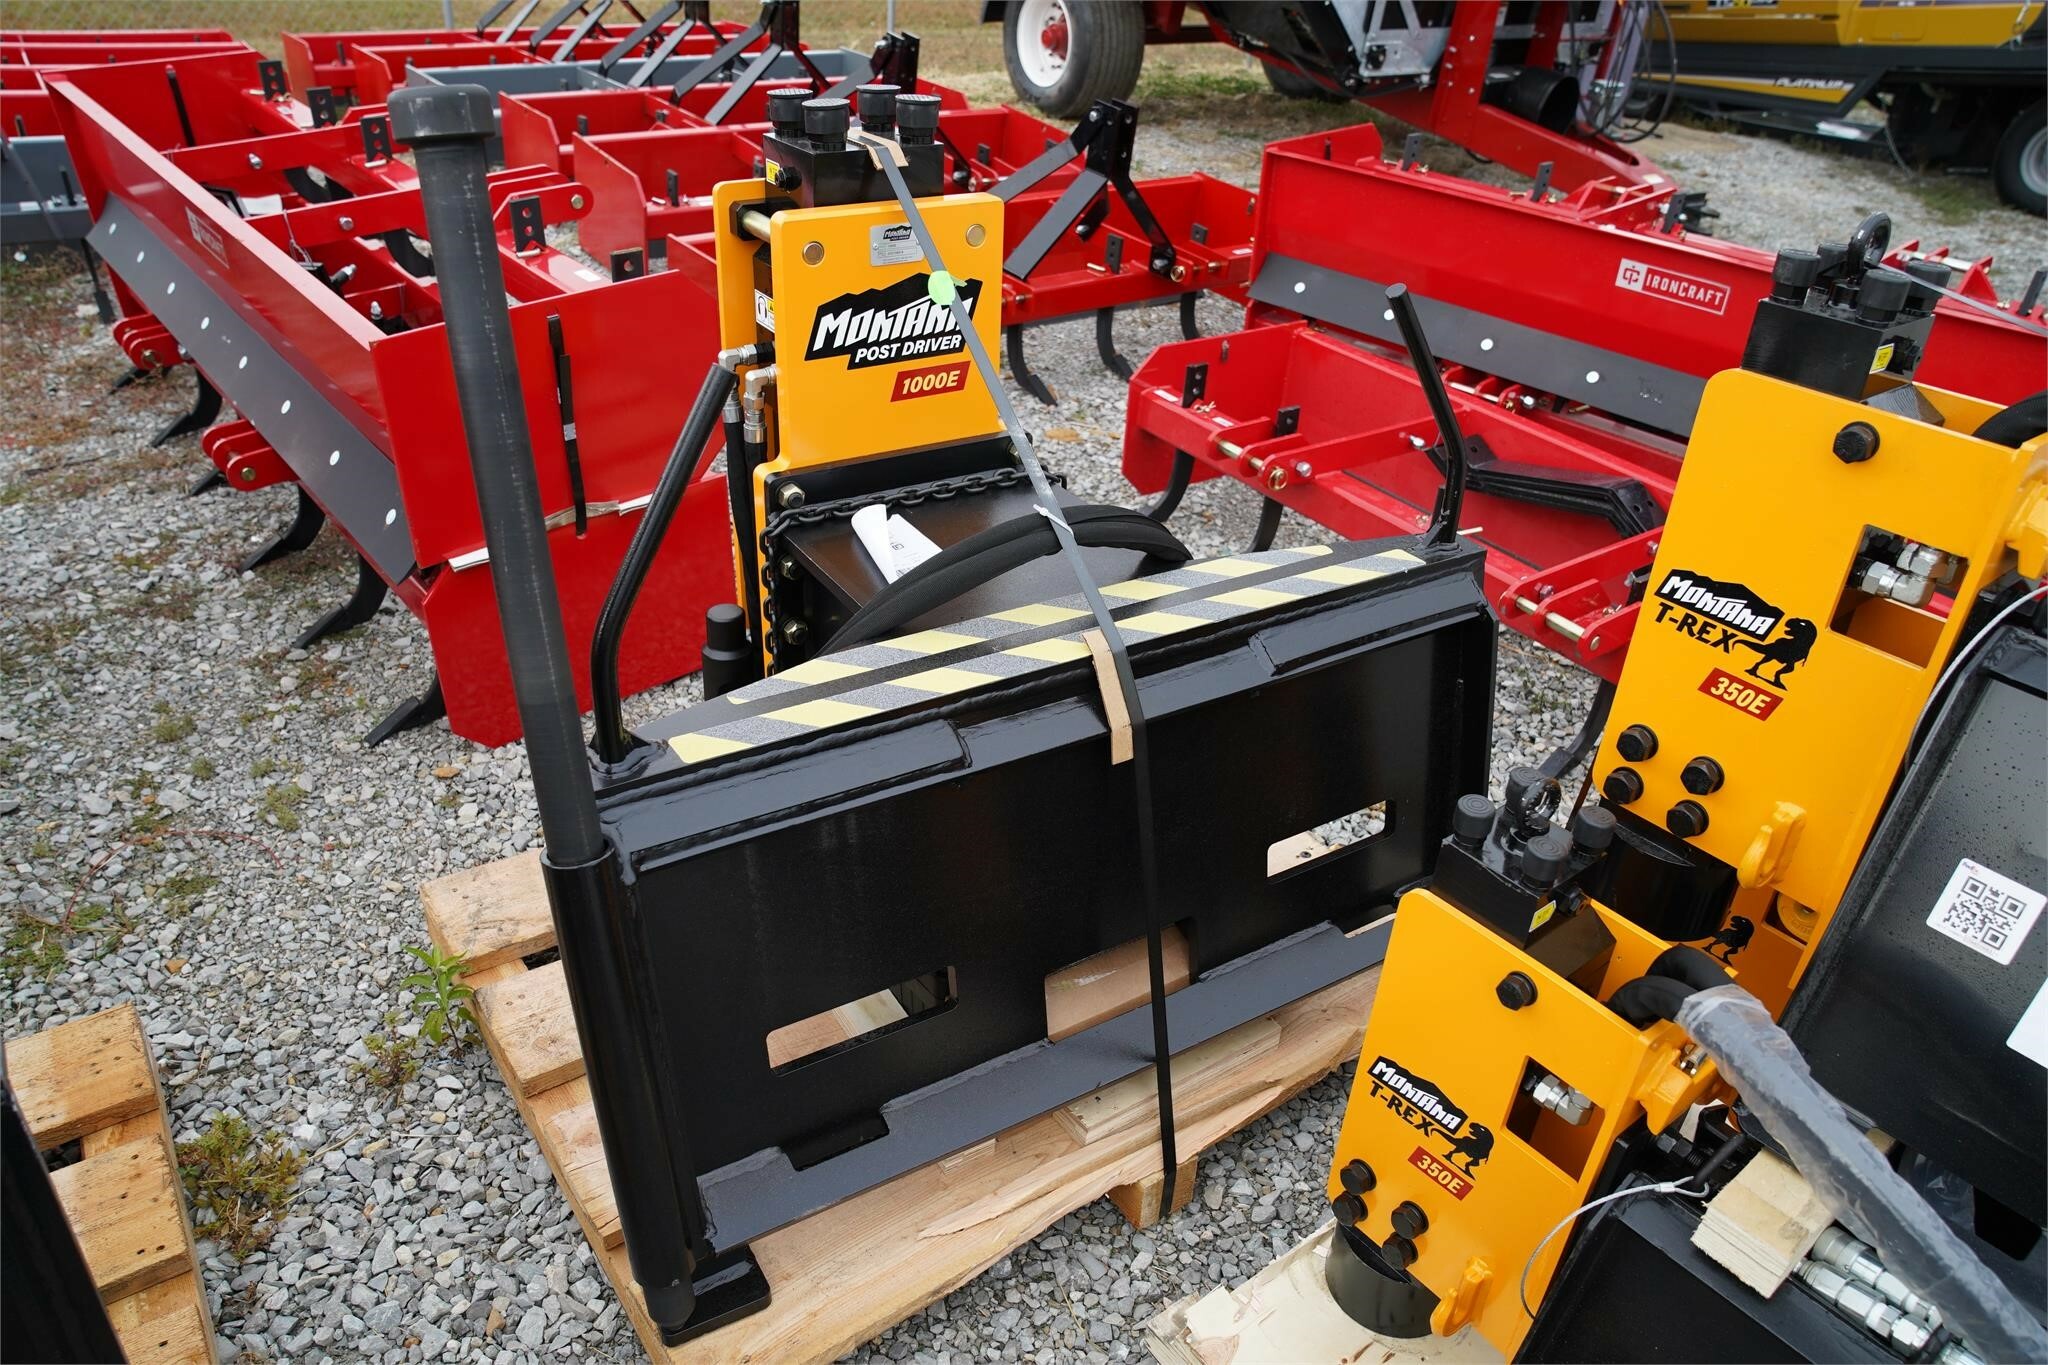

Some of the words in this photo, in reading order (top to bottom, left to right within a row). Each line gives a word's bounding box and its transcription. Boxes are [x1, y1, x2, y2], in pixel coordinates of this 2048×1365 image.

[1645, 273, 1724, 306] IRONCRAFT
[854, 342, 901, 363] POST
[901, 334, 963, 357] DRIVER
[902, 369, 961, 395] 1000E
[1660, 575, 1776, 635] MONTANA
[1655, 601, 1739, 655] T-REX
[1710, 676, 1772, 715] 350E
[1369, 1080, 1435, 1138] T-REX
[1371, 1061, 1462, 1130] MONTANA
[1416, 1154, 1465, 1195] 350E
